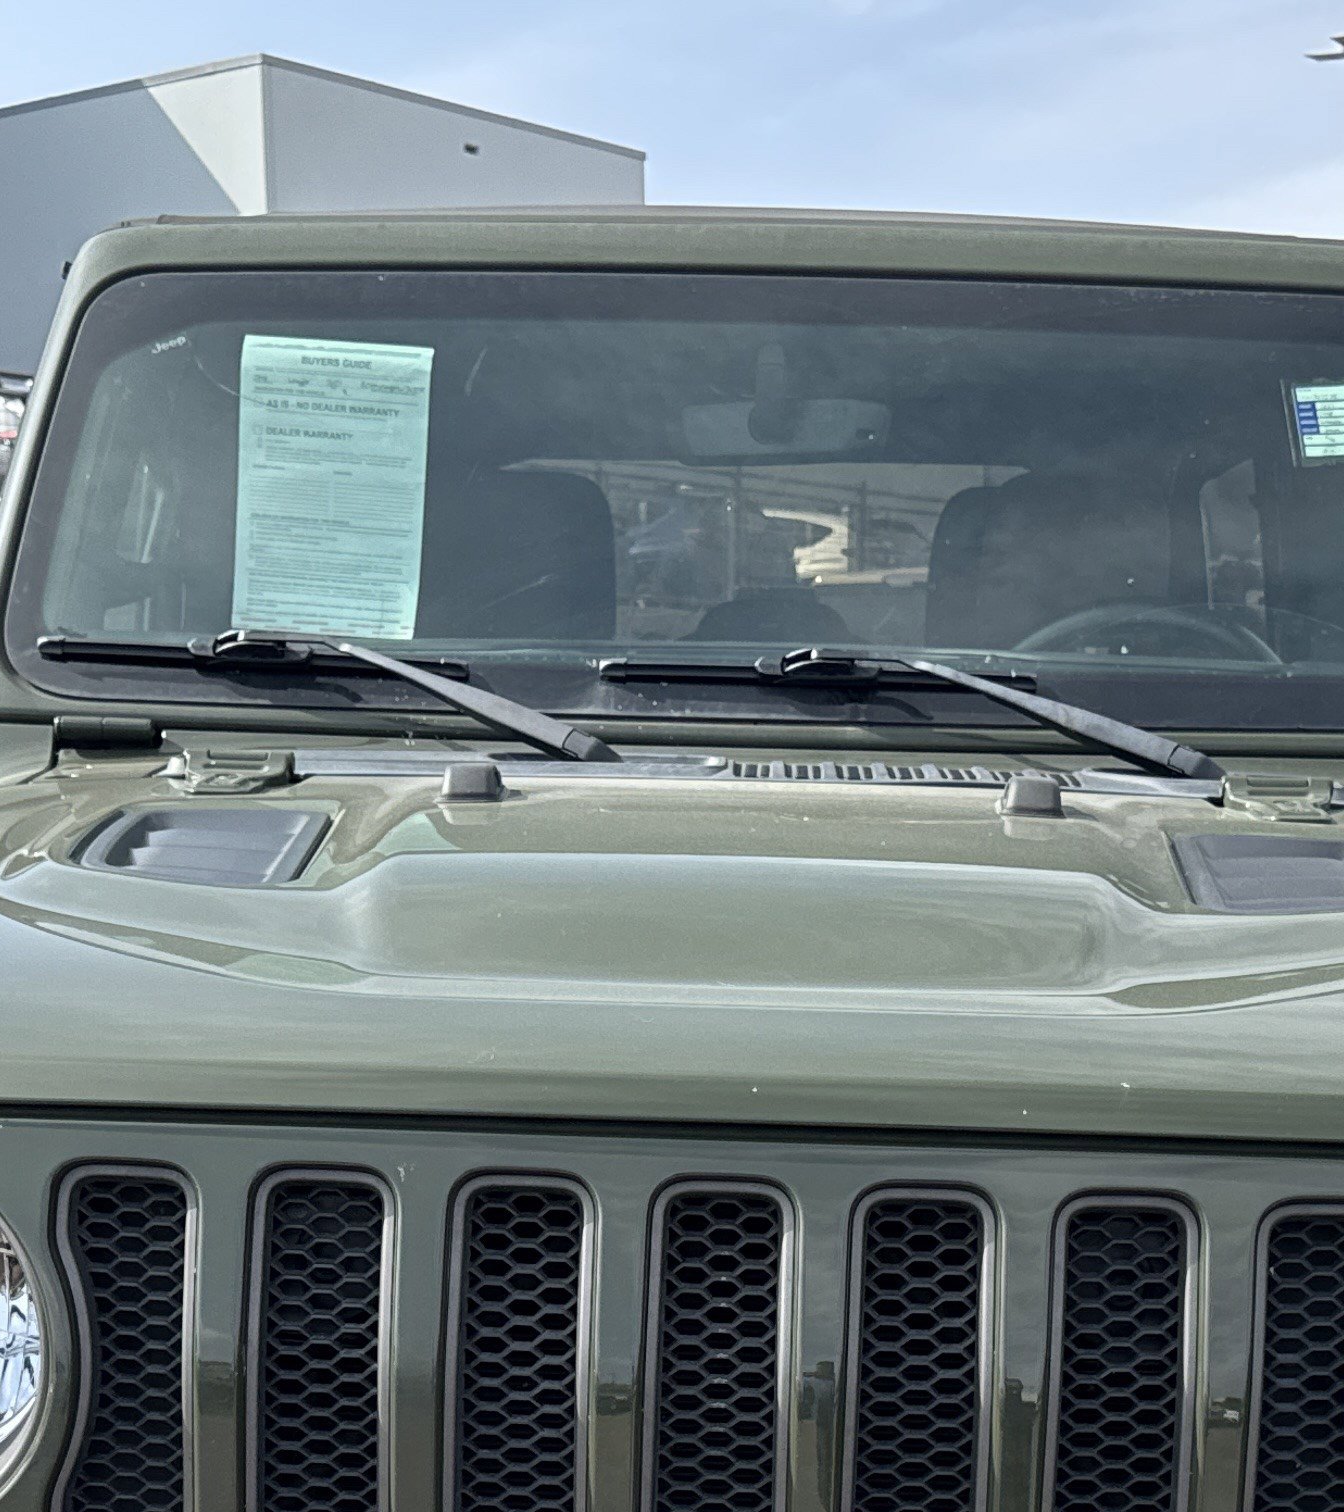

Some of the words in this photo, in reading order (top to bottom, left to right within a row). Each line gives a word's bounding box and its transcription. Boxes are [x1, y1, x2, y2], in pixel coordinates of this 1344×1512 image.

[151, 336, 186, 353] Jeep
[301, 356, 340, 367] BUYERS
[343, 358, 372, 369] GUIDE
